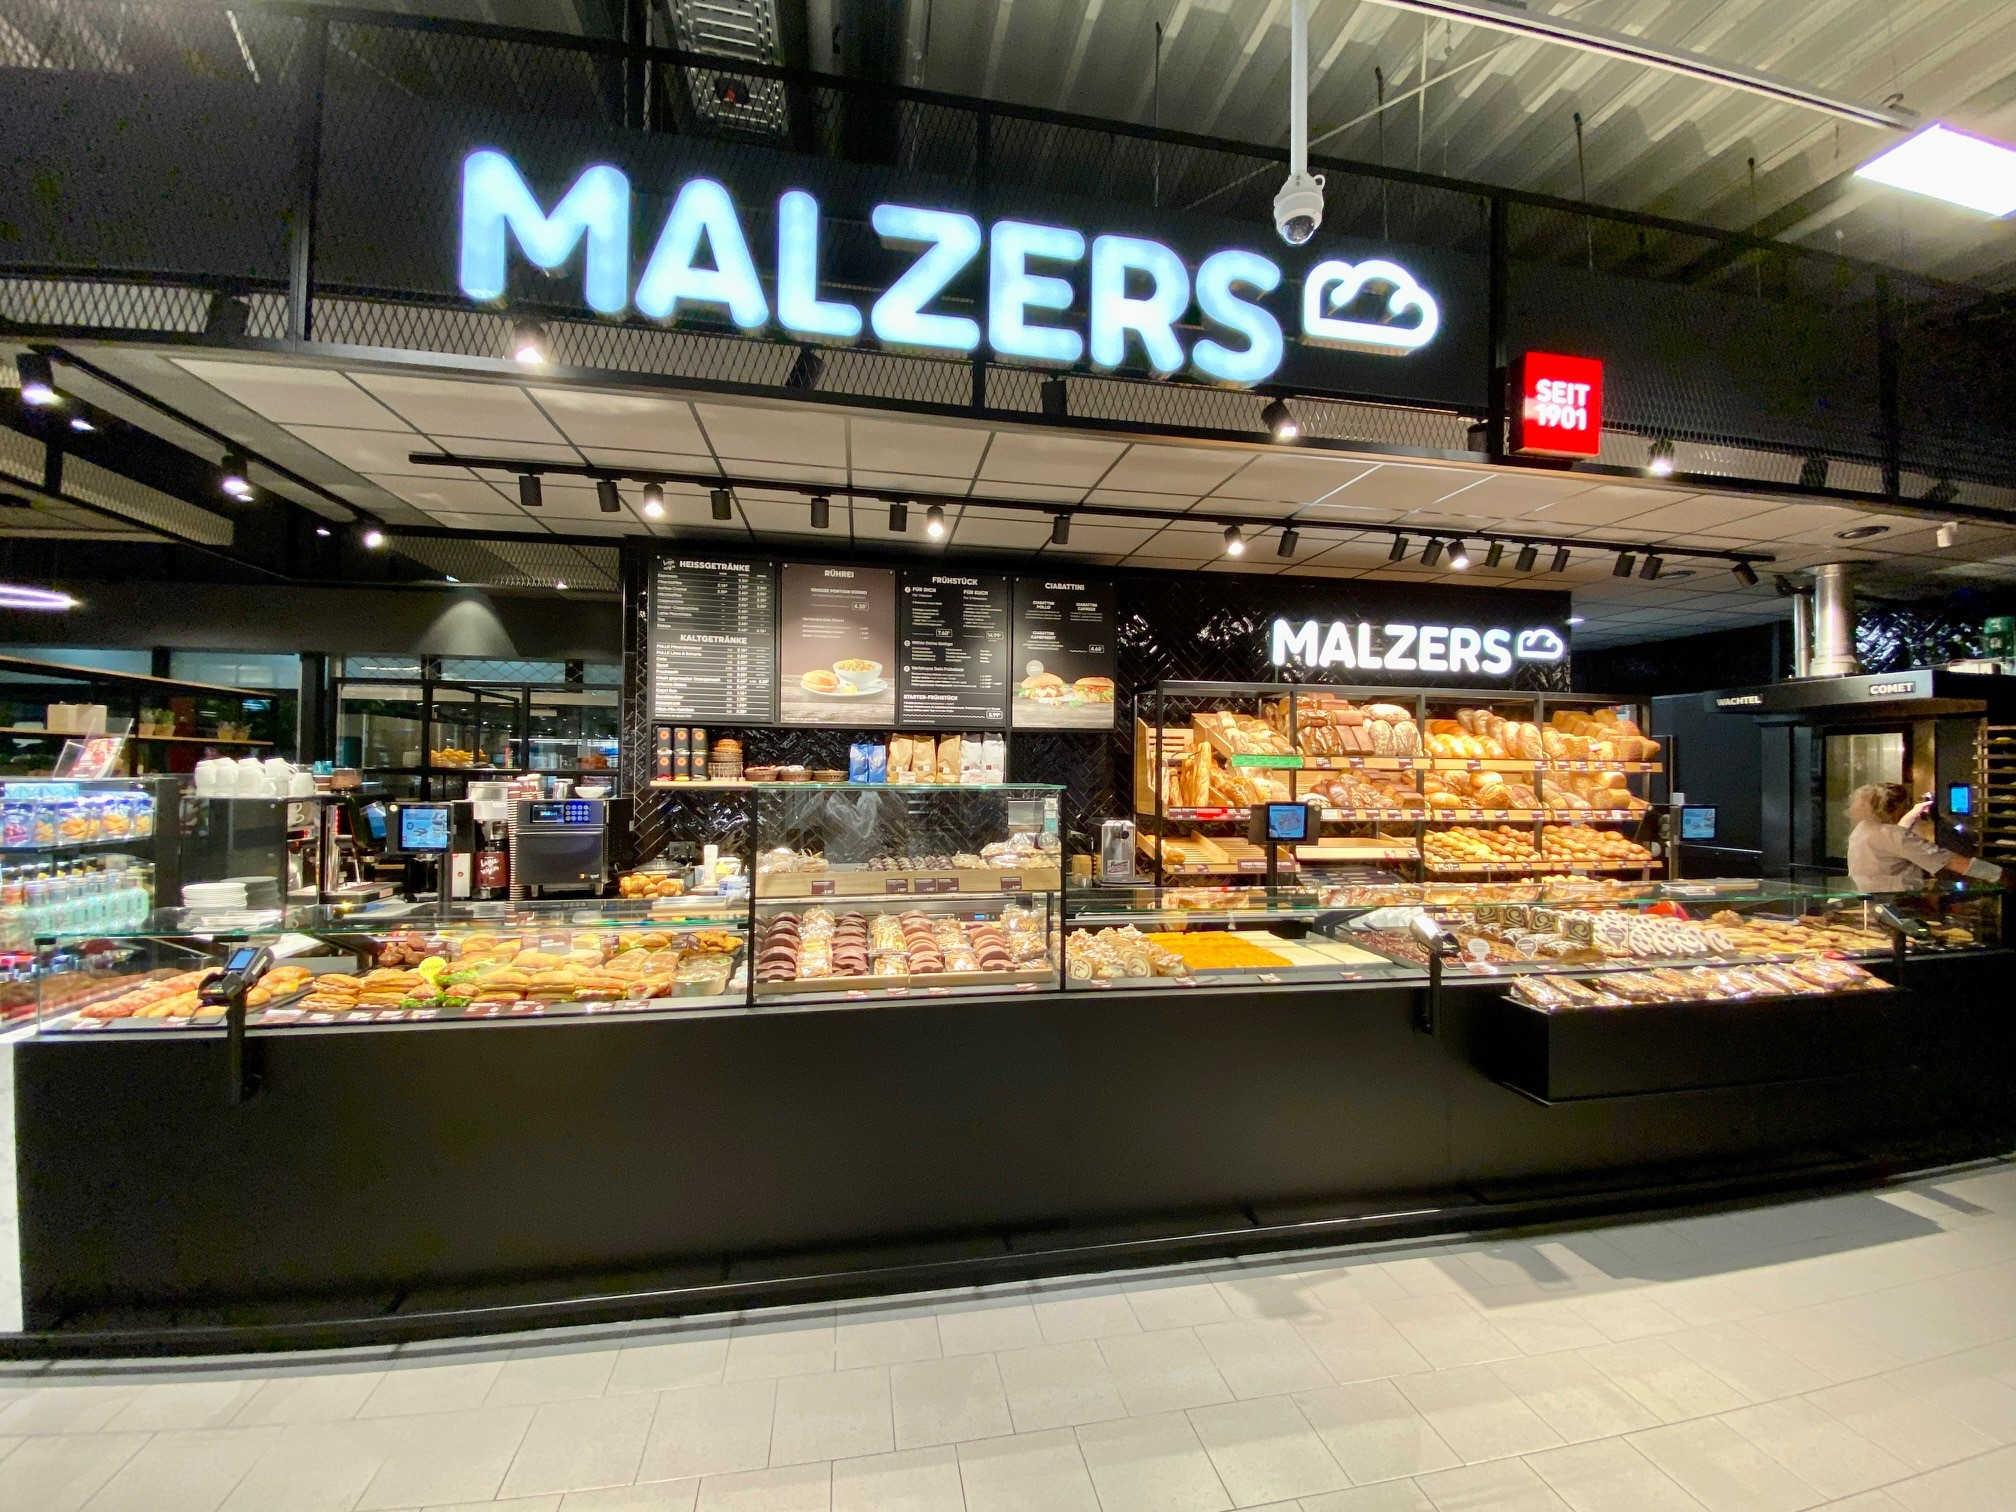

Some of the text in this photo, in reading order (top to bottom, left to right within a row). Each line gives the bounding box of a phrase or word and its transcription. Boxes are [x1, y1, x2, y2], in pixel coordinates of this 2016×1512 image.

[459, 149, 1286, 386] MALZERS
[1536, 378, 1591, 406] SEIT
[1534, 403, 1587, 431] 1901
[679, 560, 750, 572] HEISSGETRÄNKE
[824, 569, 854, 578] RÜHREI
[932, 576, 978, 586] FRÜHSTÜCK
[1045, 582, 1085, 591] CIABATTINI
[680, 634, 748, 645] KALTGETRÄNKE
[1271, 618, 1512, 675] MALZERS
[1869, 682, 1914, 695] COMET
[1716, 695, 1762, 706] WACHTEL
